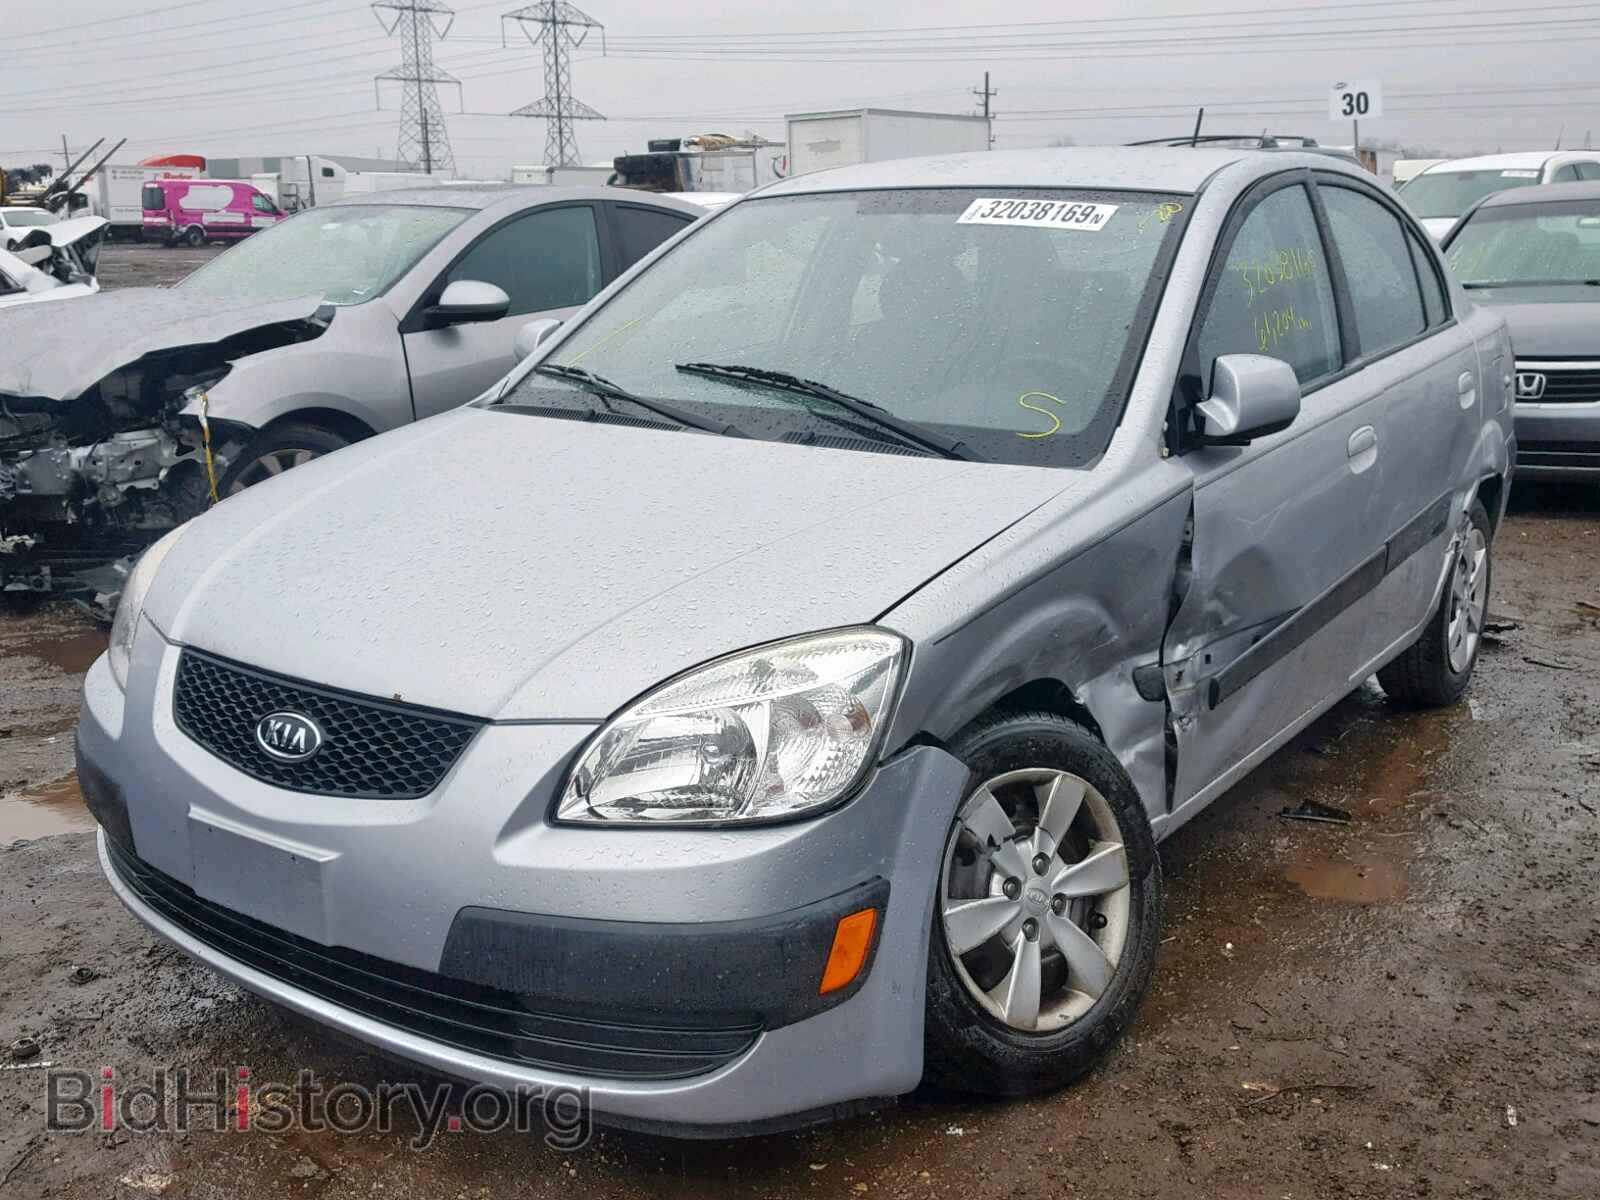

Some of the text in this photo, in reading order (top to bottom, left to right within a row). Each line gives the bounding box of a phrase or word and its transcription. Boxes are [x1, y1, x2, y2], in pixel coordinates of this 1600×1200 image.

[1342, 91, 1369, 116] 30
[1015, 391, 1067, 438] S
[264, 719, 306, 752] KIA
